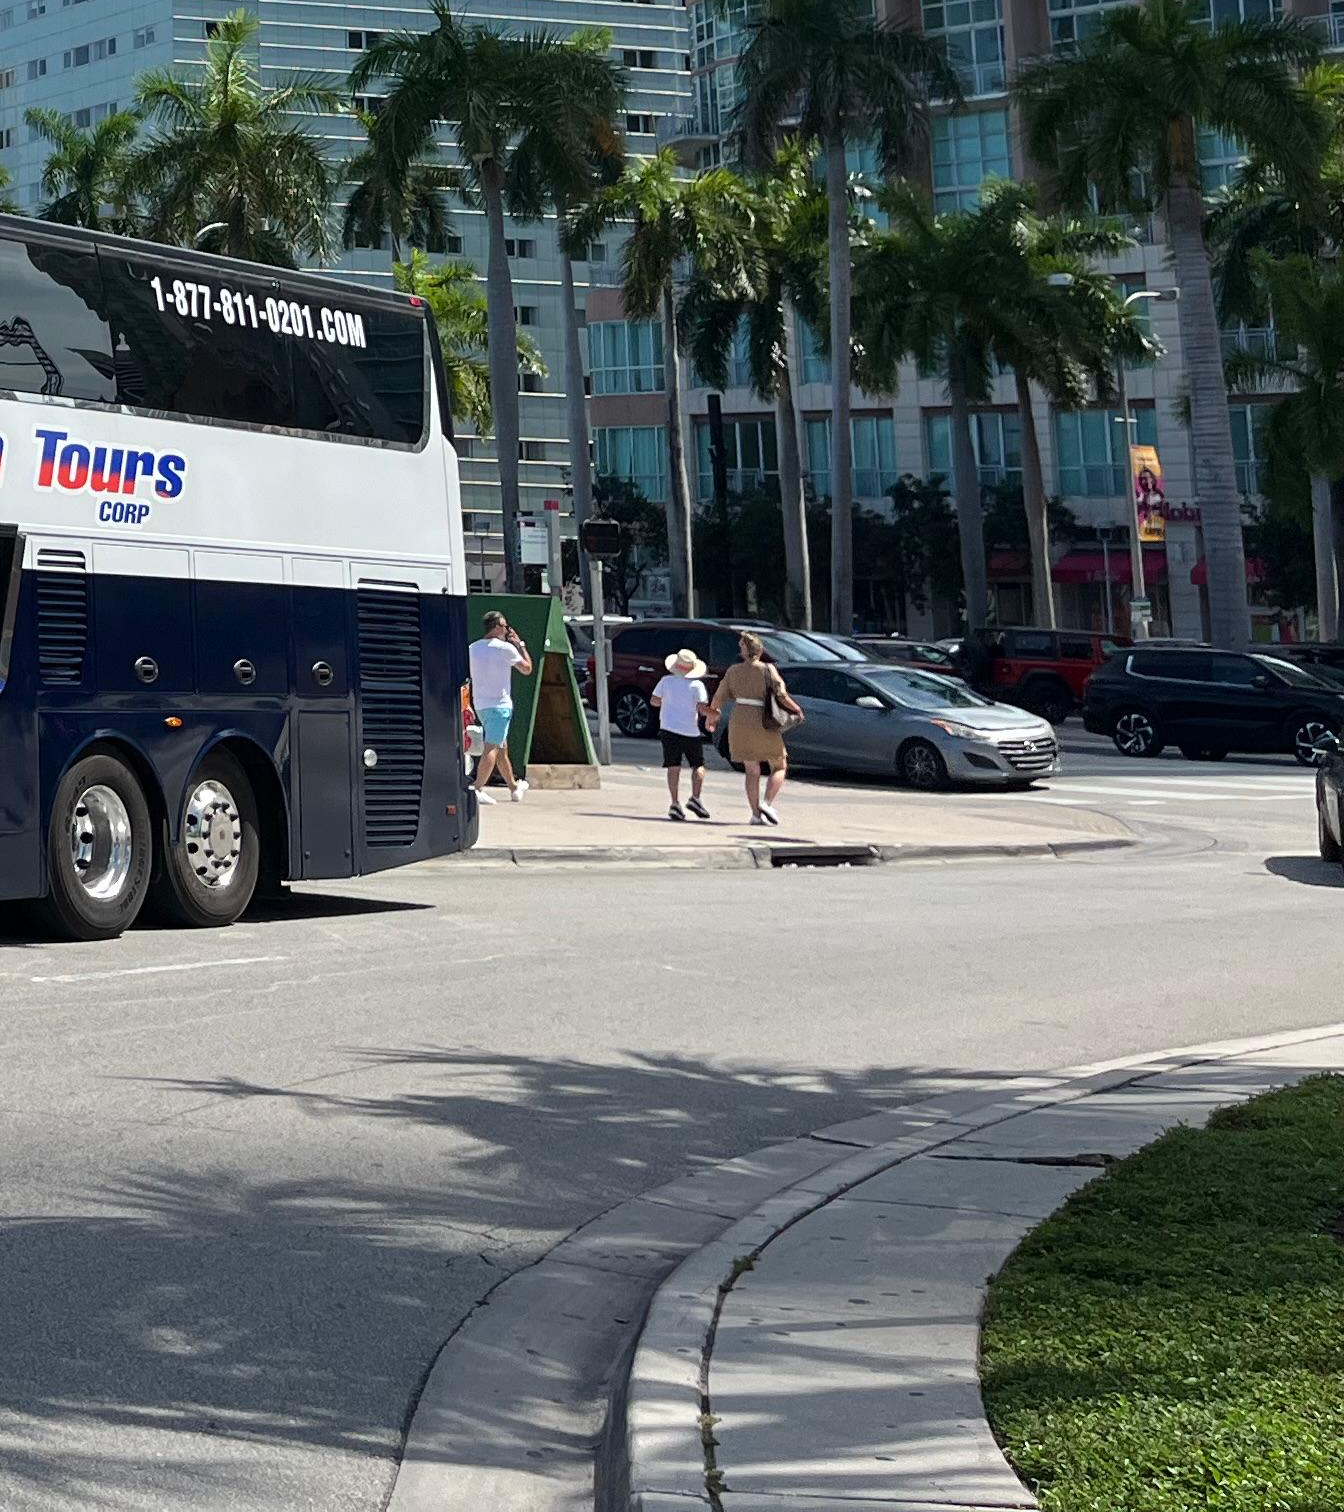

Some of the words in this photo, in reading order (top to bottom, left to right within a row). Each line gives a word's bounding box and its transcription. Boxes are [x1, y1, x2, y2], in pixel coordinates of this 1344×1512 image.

[150, 276, 367, 348] 1-877-811-0201.COM
[35, 428, 186, 500] Tours
[98, 500, 151, 525] CORP
